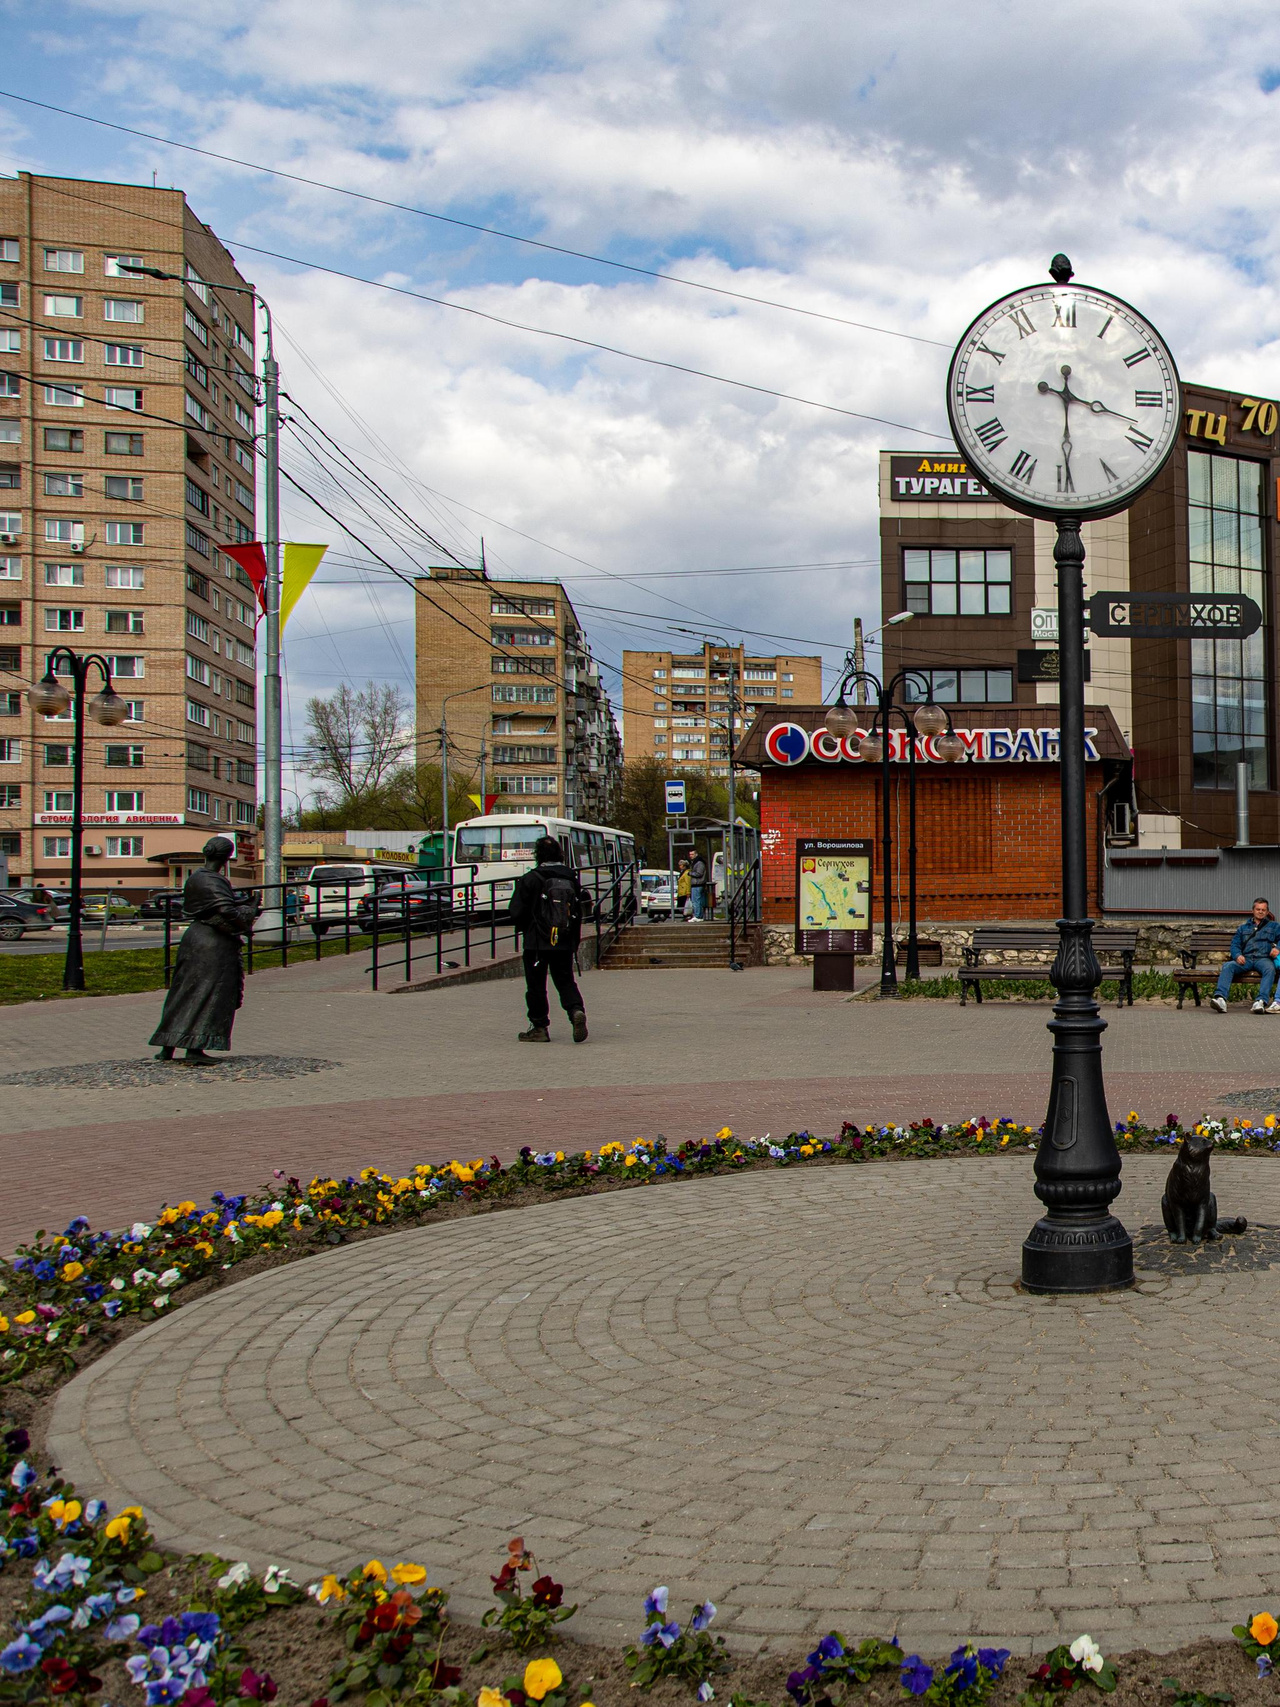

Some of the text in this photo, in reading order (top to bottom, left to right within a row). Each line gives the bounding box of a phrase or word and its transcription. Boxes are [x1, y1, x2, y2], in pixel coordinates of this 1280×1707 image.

[1187, 398, 1278, 446] ТЦ 70
[918, 460, 968, 473] Амиг
[1110, 603, 1242, 627] СЕРПУХОВ
[40, 815, 178, 823] СТОМАОЛОГИЯ АВИЦЕННА
[817, 841, 864, 849] Ворошилова
[381, 849, 410, 862] КОЛОБОК
[817, 858, 855, 871] Серпухов
